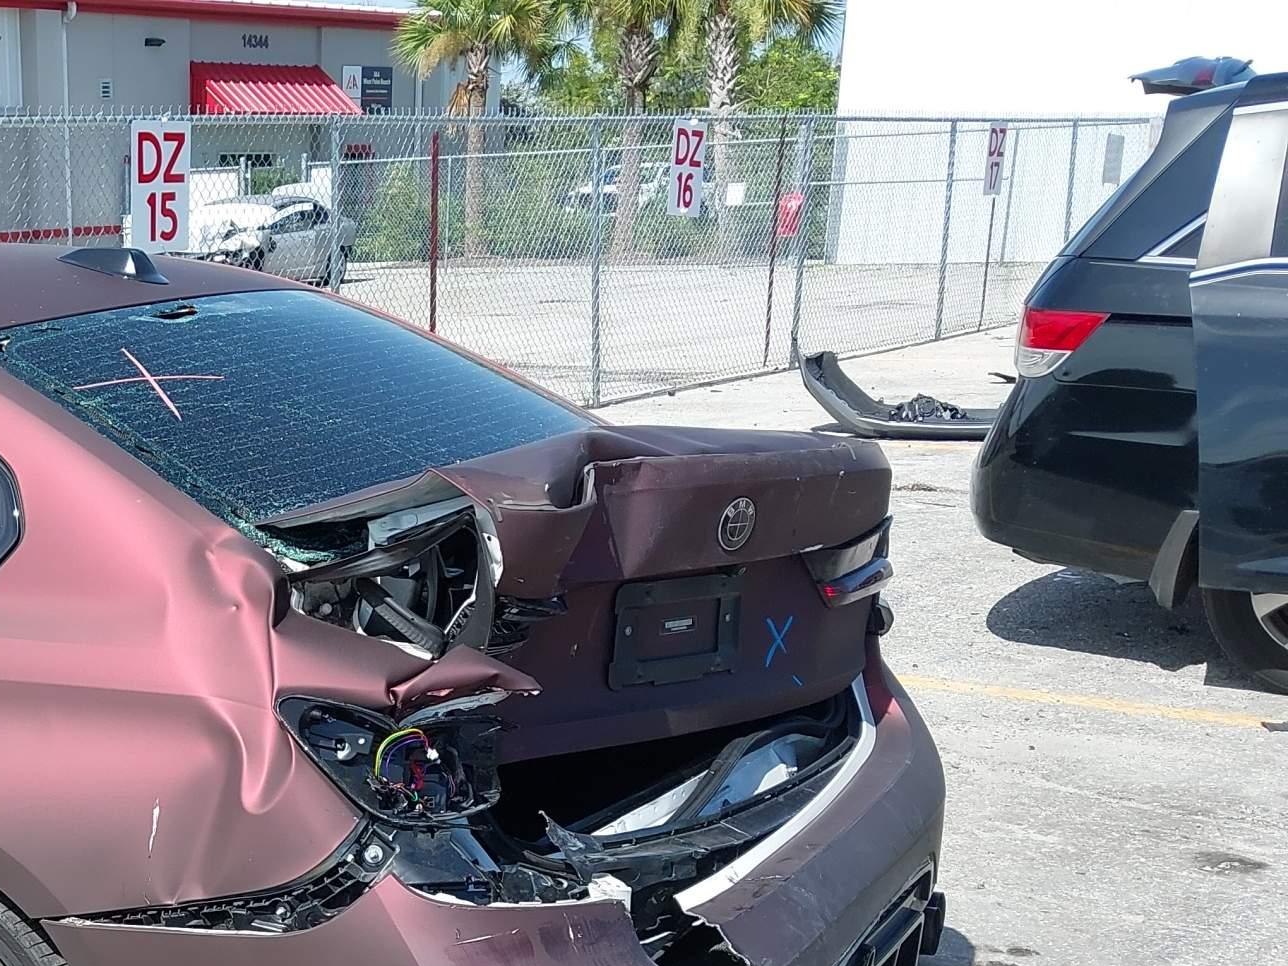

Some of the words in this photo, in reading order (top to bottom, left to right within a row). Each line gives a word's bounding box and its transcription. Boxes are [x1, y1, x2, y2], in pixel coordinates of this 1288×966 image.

[242, 33, 269, 48] 14344
[138, 131, 186, 184] DZ
[675, 127, 705, 168] DZ
[988, 127, 1008, 157] DZ
[676, 171, 694, 208] 16
[989, 161, 1001, 190] 17
[146, 191, 178, 242] 15
